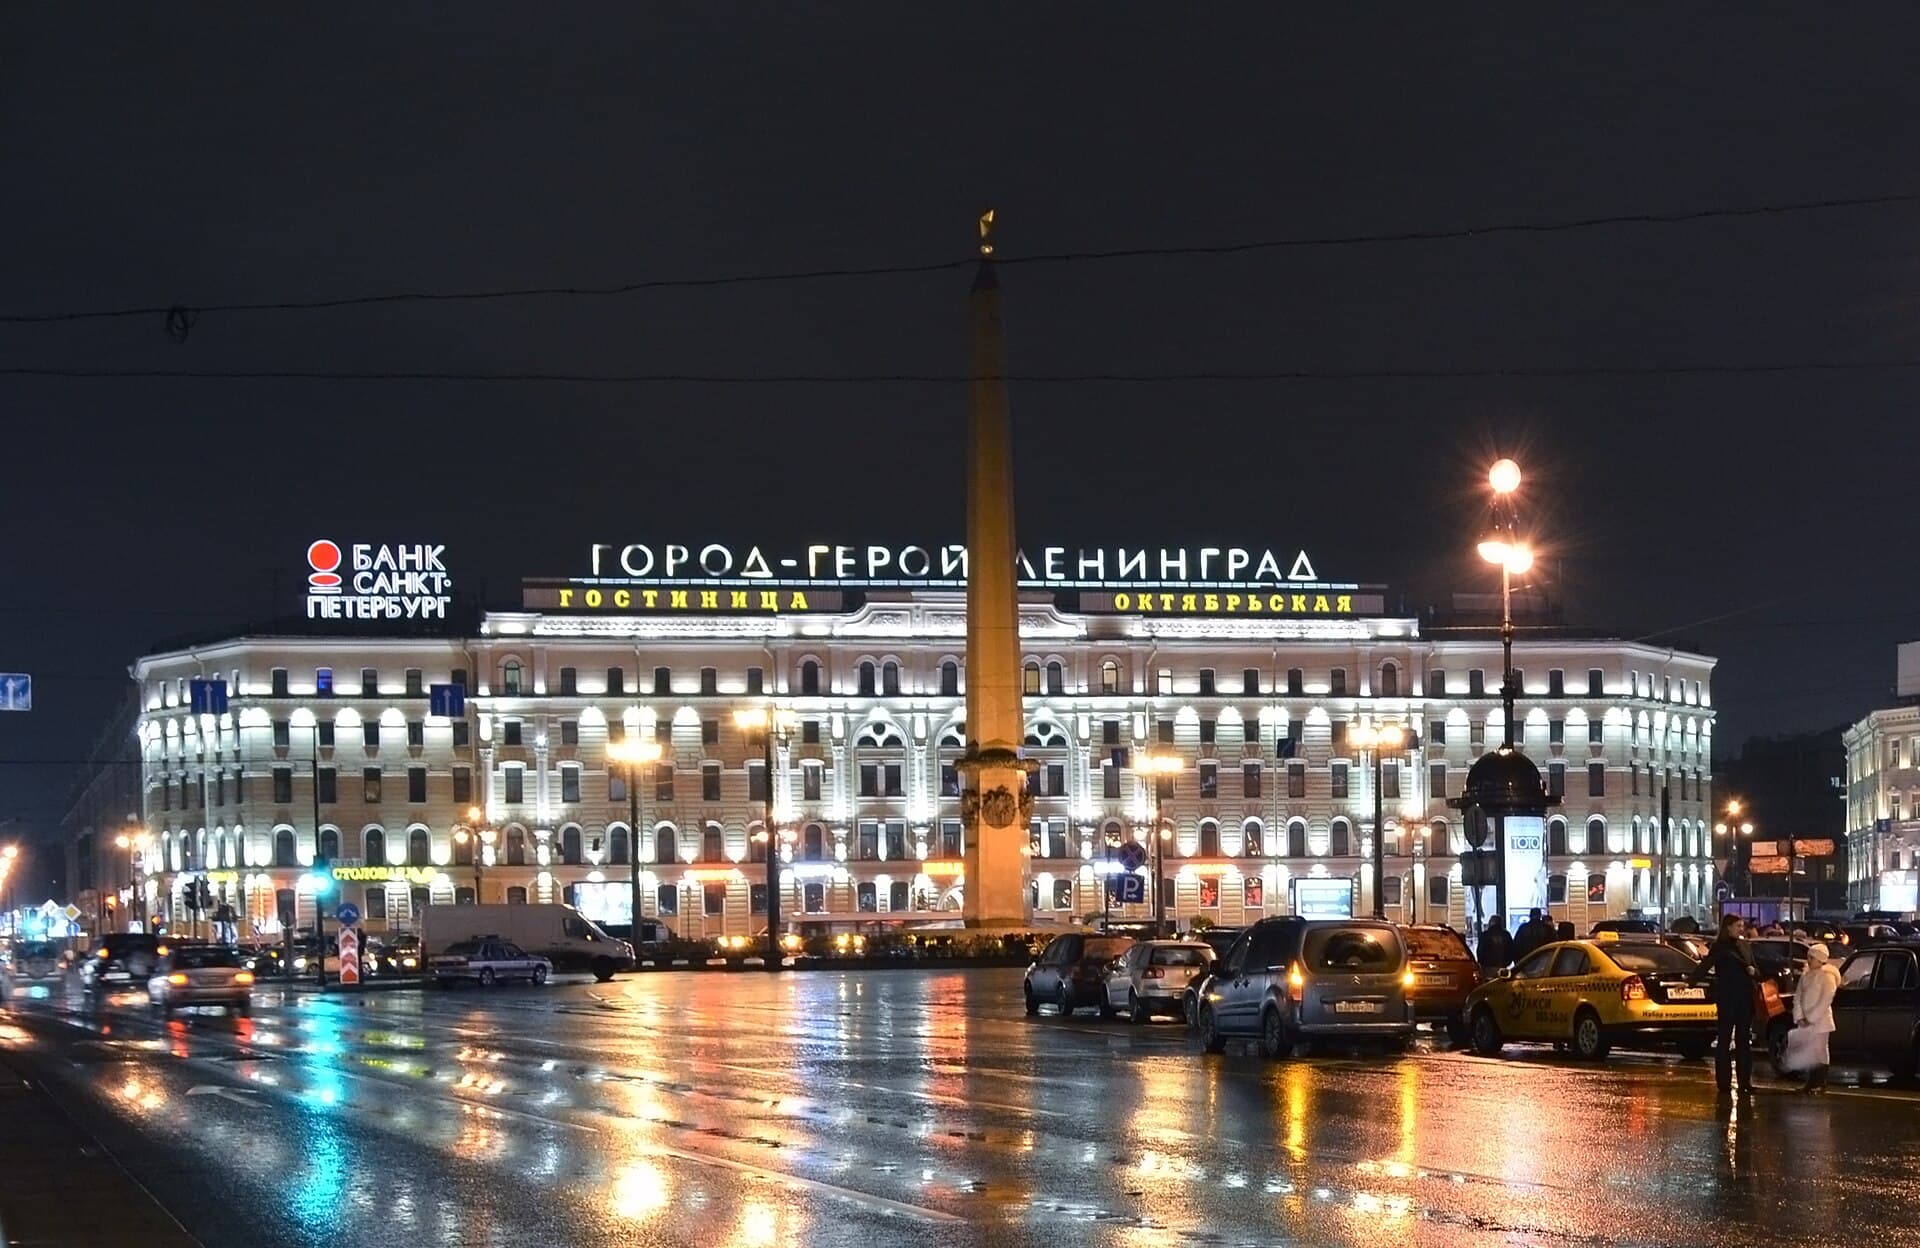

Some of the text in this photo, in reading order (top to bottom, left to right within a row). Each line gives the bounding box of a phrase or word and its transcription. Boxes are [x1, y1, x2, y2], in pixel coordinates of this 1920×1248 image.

[352, 544, 446, 570] БАНК
[592, 544, 1318, 580] ГОРОД-ГЕРОЙ ЛЕНИНГРАД
[307, 596, 451, 619] ПЕТЕРБУРГ
[559, 589, 1352, 612] ГОСТИНИЦА ОКТЯБРЬСКАЯ
[1511, 836, 1540, 850] TOTO
[1123, 876, 1139, 900] P
